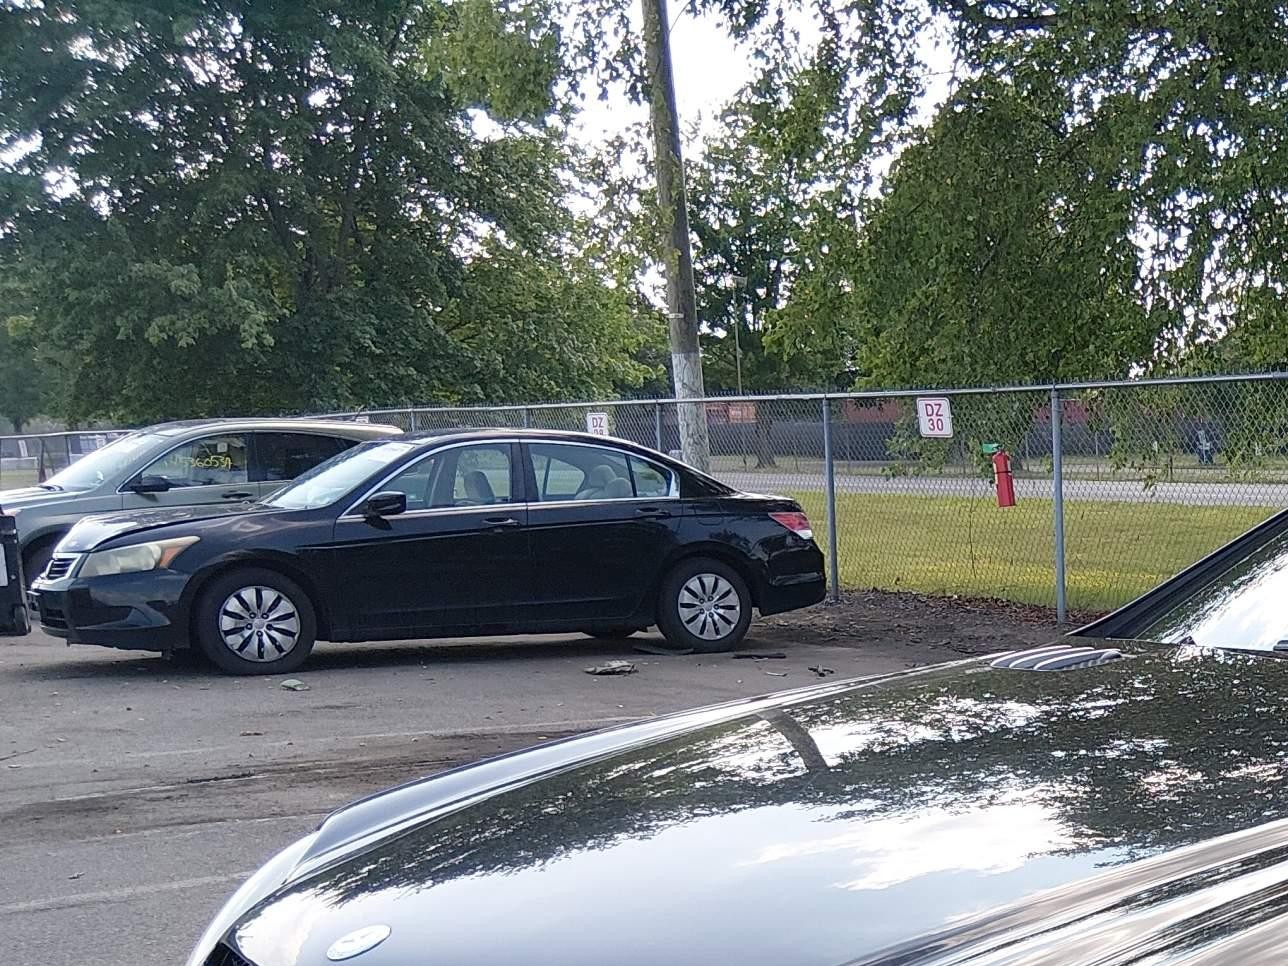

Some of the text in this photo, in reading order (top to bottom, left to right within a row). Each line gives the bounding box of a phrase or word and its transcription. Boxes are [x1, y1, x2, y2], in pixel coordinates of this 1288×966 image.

[925, 403, 943, 417] DZ
[592, 417, 604, 428] DZ
[928, 418, 944, 431] 30
